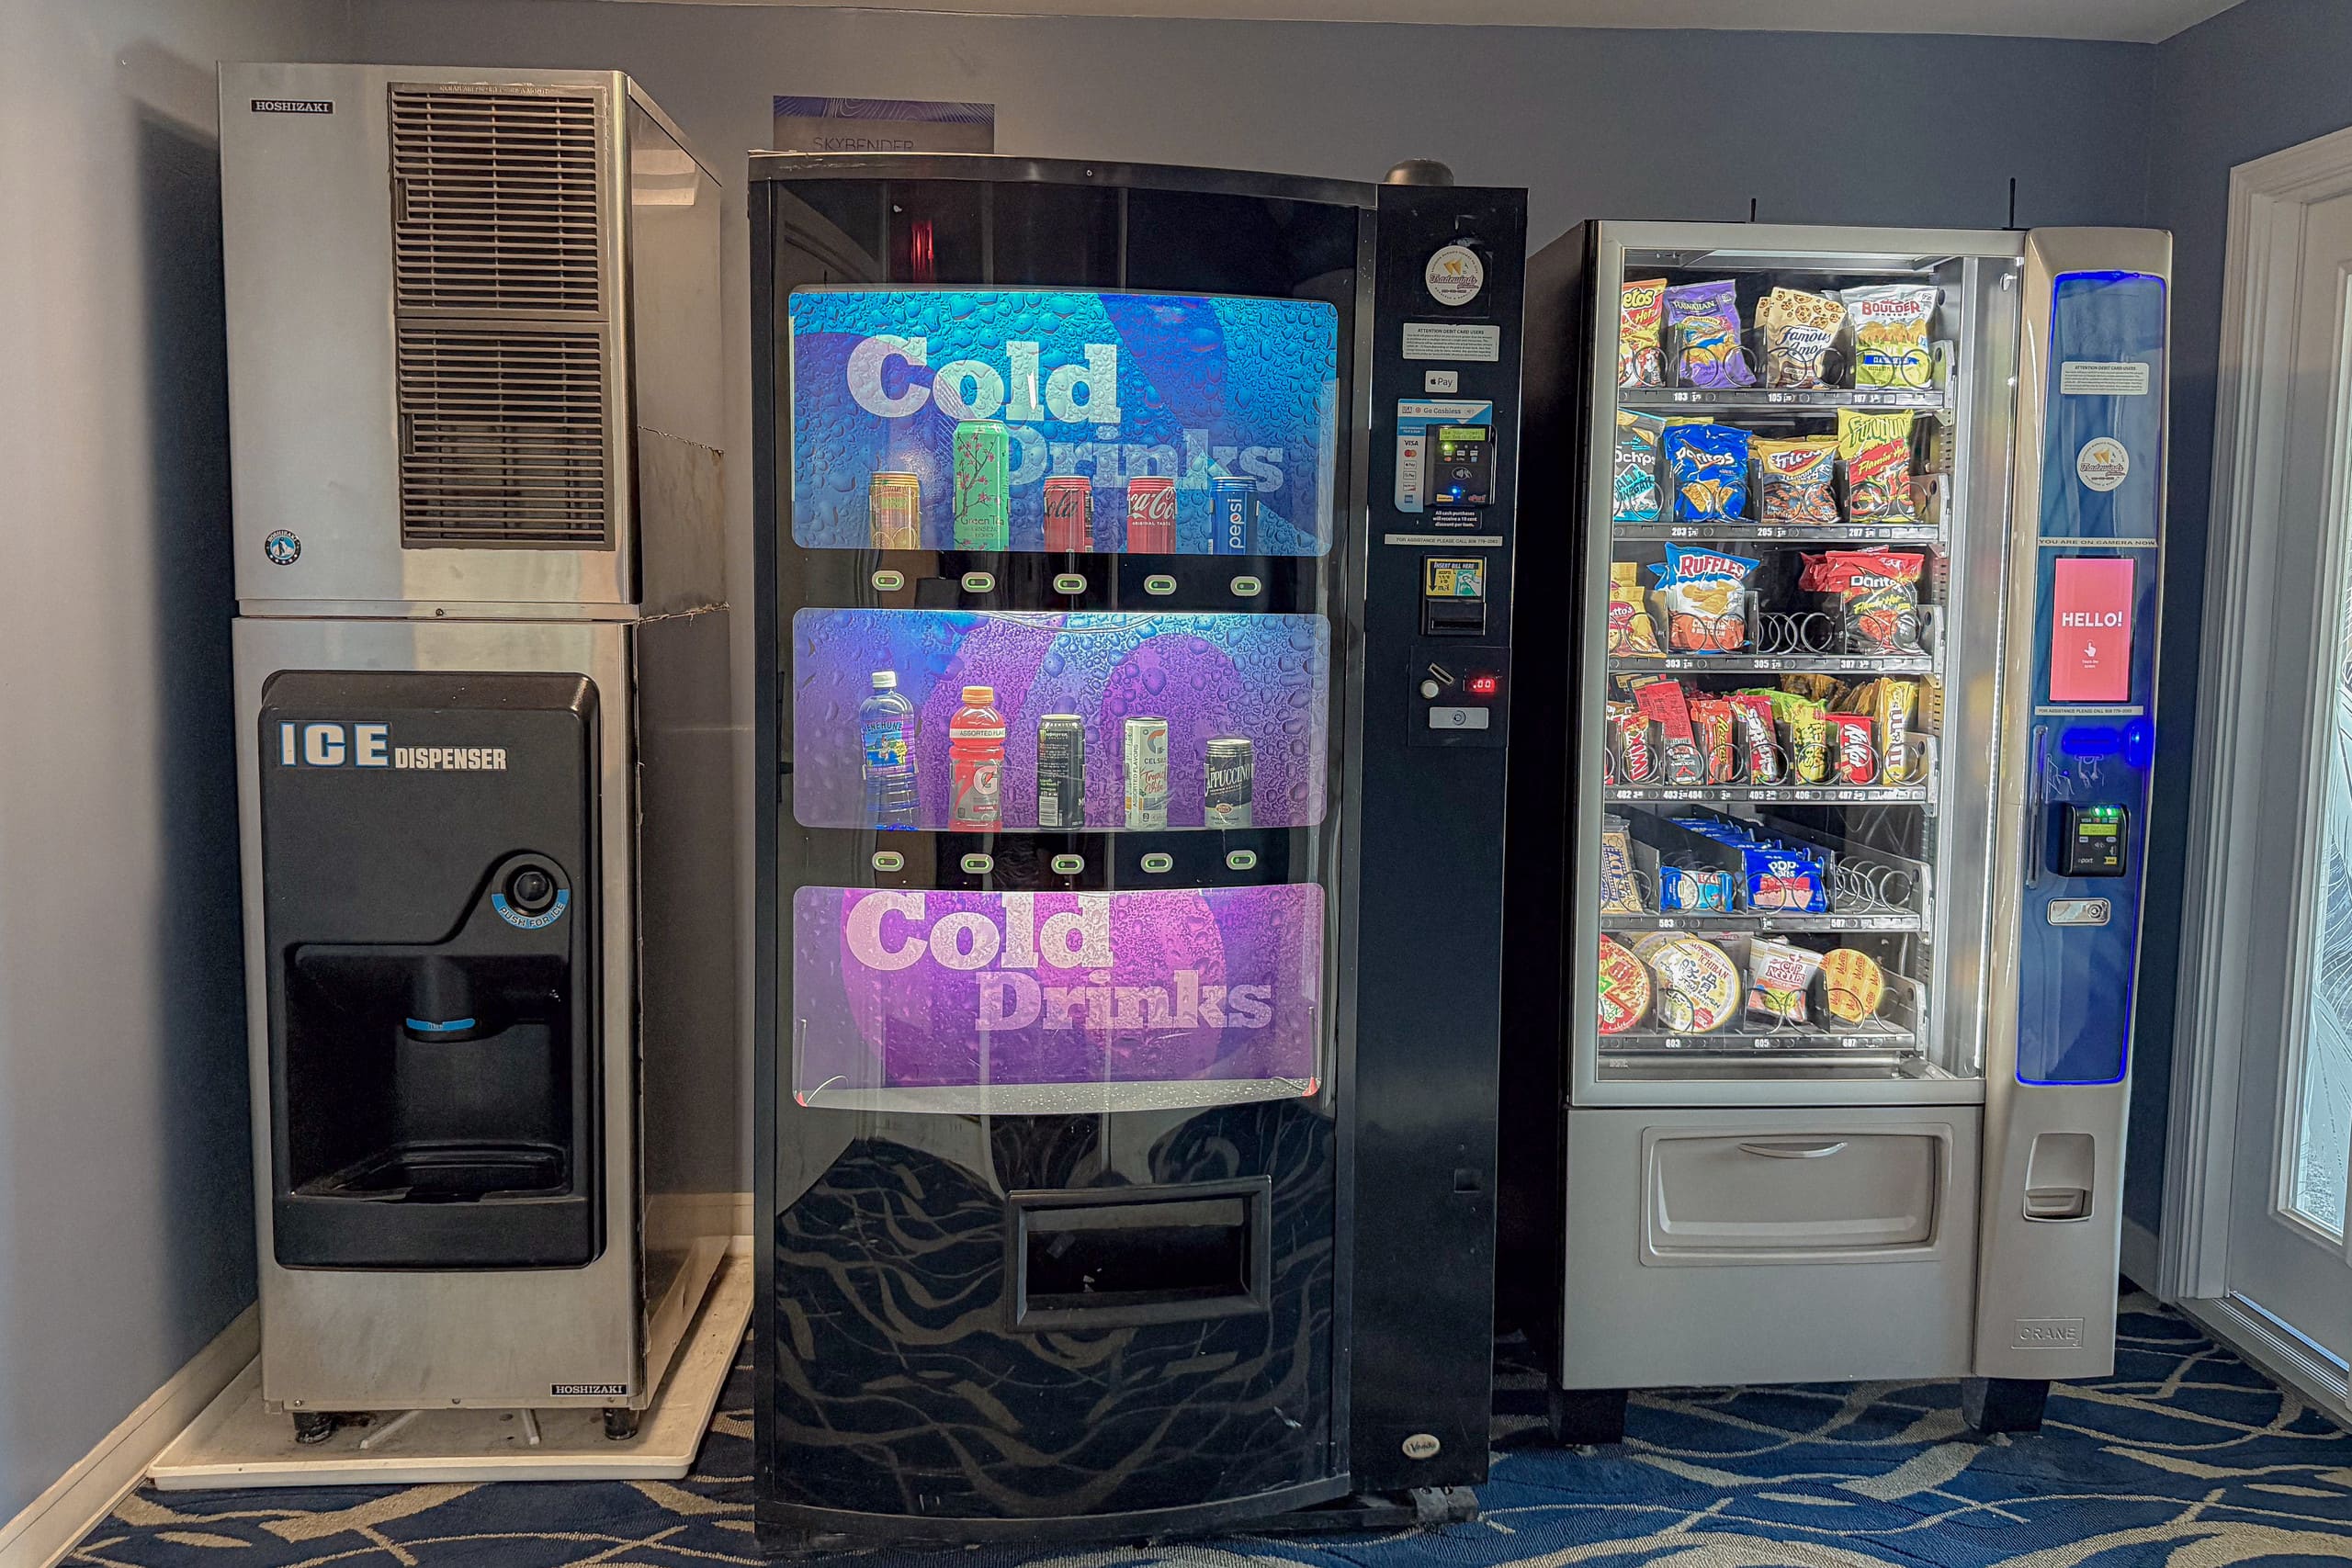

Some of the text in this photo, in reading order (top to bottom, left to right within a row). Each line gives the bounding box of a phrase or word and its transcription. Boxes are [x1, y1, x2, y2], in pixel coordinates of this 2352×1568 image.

[255, 101, 329, 112] HOSHIZAKI
[1623, 288, 1654, 309] etos
[1672, 300, 1716, 312] HAWAIIAN
[1861, 299, 1921, 316] BOULDER
[1776, 326, 1831, 346] Famous
[846, 334, 1122, 424] Cold
[1437, 378, 1453, 388] Pay
[1674, 392, 1689, 401] 103
[1768, 392, 1782, 401] 105
[1853, 392, 1867, 401] 107
[1849, 416, 1909, 448] FUNYUN
[1008, 425, 1284, 492] Drinks
[1676, 446, 1736, 467] Doritos
[961, 515, 989, 525] Green
[1227, 498, 1245, 549] pepsi
[1672, 527, 1687, 536] 203
[1757, 527, 1773, 536] 205
[1849, 528, 1863, 537] 207
[1680, 555, 1744, 579] RUFFLES
[2062, 611, 2122, 627] HELLO!
[1665, 659, 1680, 668] 303
[1753, 659, 1769, 669] 305
[279, 722, 507, 770] ICE DISPENSER
[974, 765, 998, 795] G
[1749, 790, 1764, 799] 405
[500, 903, 565, 927] PUSH FOR ICE
[845, 891, 1113, 971] Cold
[1697, 955, 1730, 979] ICHIBAN
[1780, 960, 1804, 975] CUP
[1765, 965, 1806, 985] NOODLES
[975, 970, 1272, 1031] Drinks
[1666, 1038, 1681, 1047] 603
[2020, 1326, 2076, 1340] CRANE
[555, 1385, 623, 1394] HOSHIZAKI
